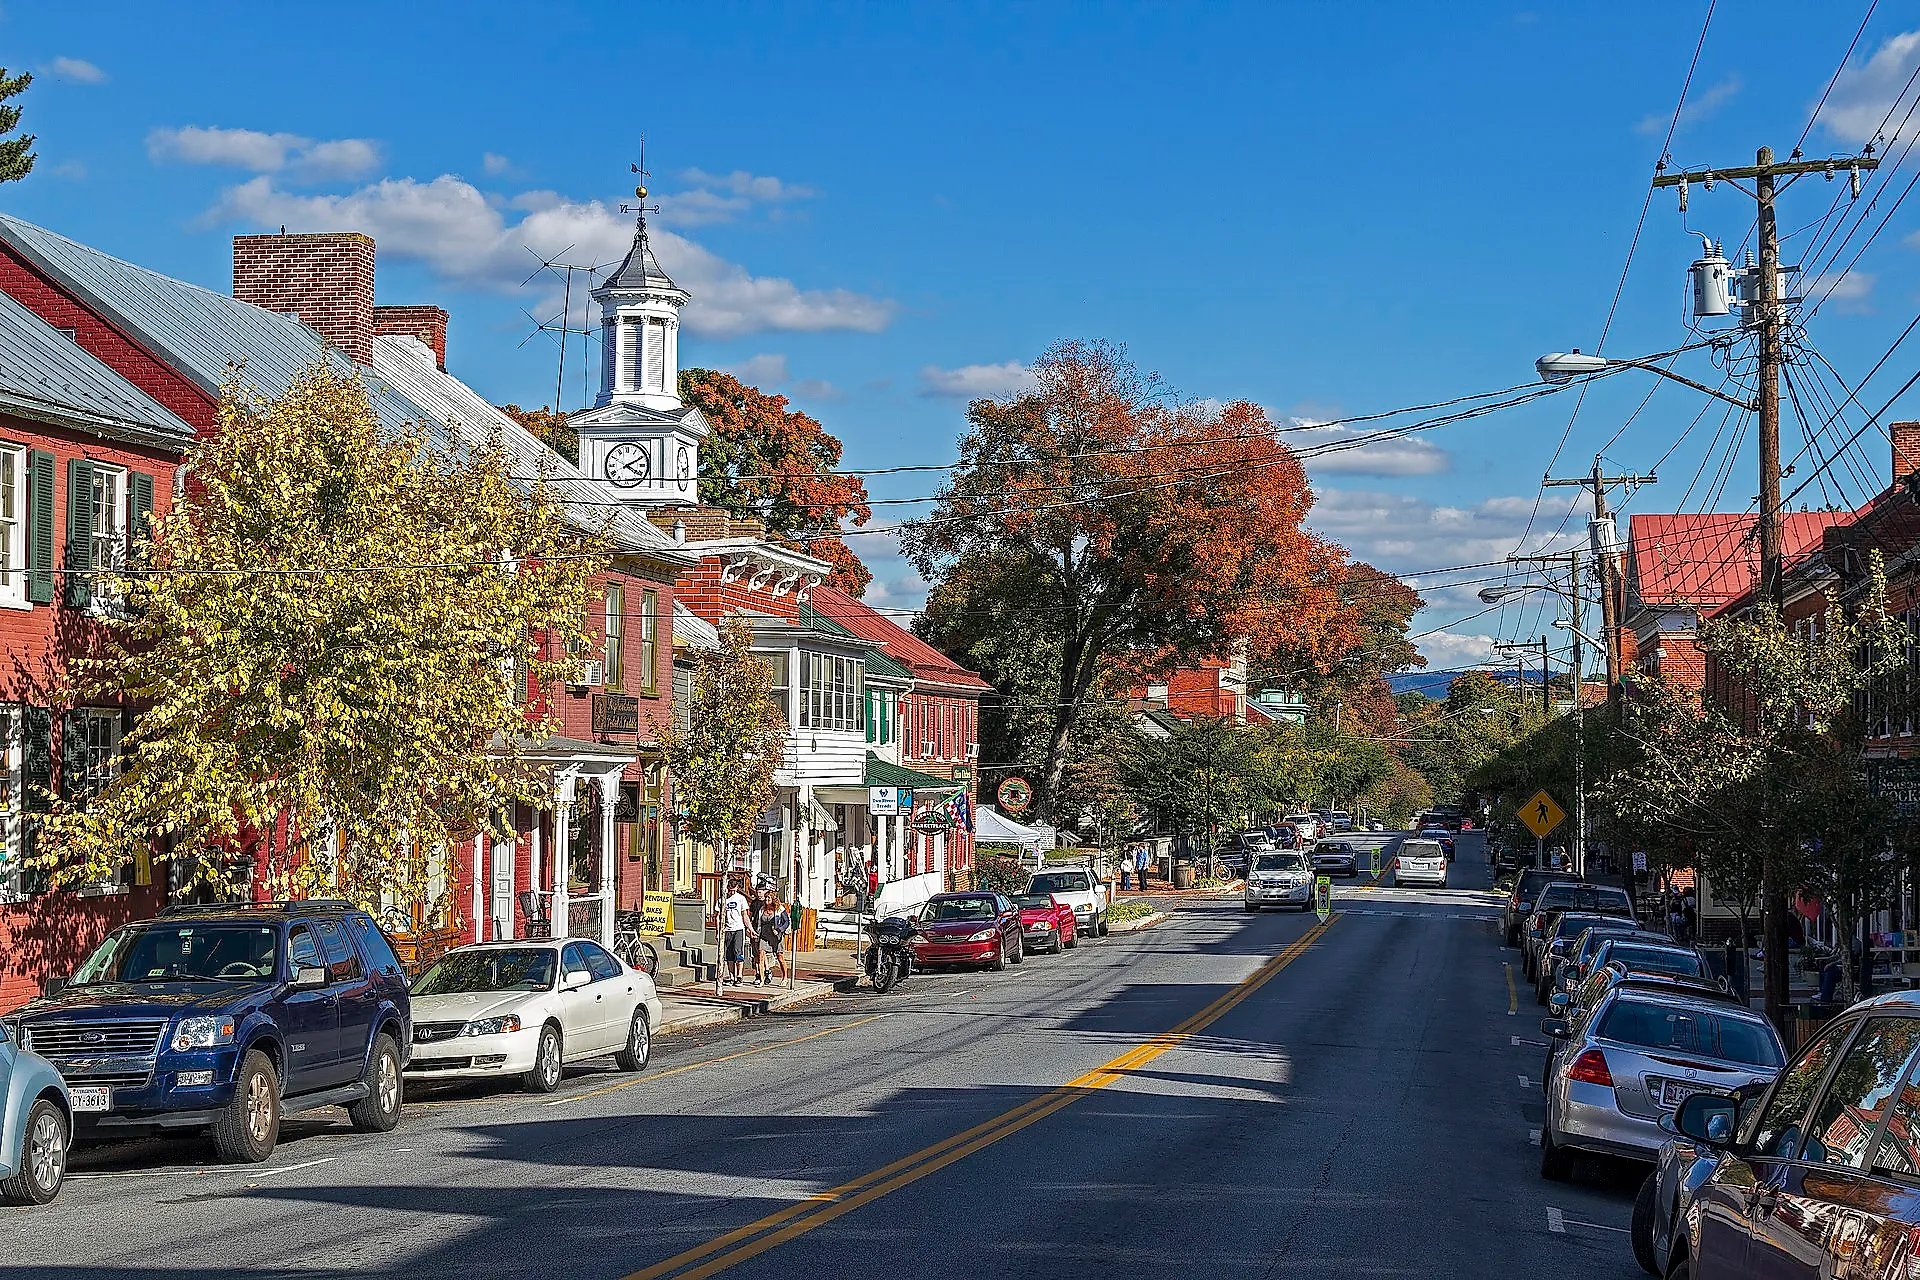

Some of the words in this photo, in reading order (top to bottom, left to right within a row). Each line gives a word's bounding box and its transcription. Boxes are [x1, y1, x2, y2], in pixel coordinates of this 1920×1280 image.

[645, 894, 669, 902] RENTALS
[646, 906, 662, 914] BIKES
[641, 915, 666, 923] KAYAKS
[640, 923, 665, 932] CANOES
[71, 1094, 107, 1107] CY-3613
